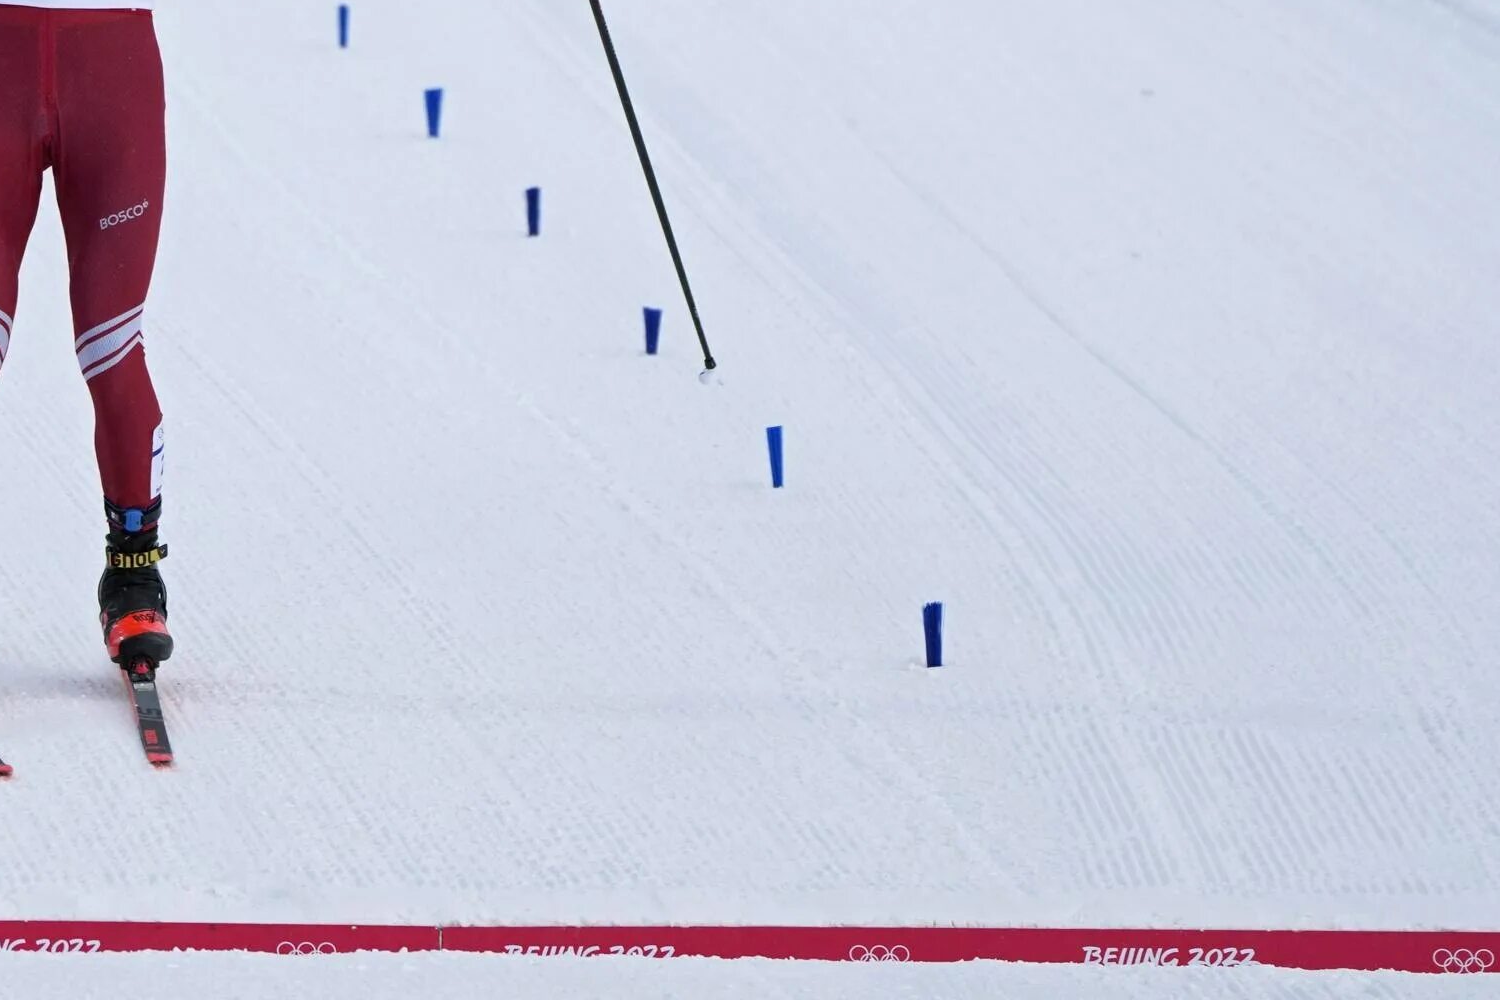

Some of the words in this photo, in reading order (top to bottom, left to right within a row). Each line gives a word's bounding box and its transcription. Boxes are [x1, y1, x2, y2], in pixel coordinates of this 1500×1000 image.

[99, 204, 144, 230] BOSCO
[1082, 945, 1180, 967] BEIJING
[1187, 946, 1259, 967] 2022
